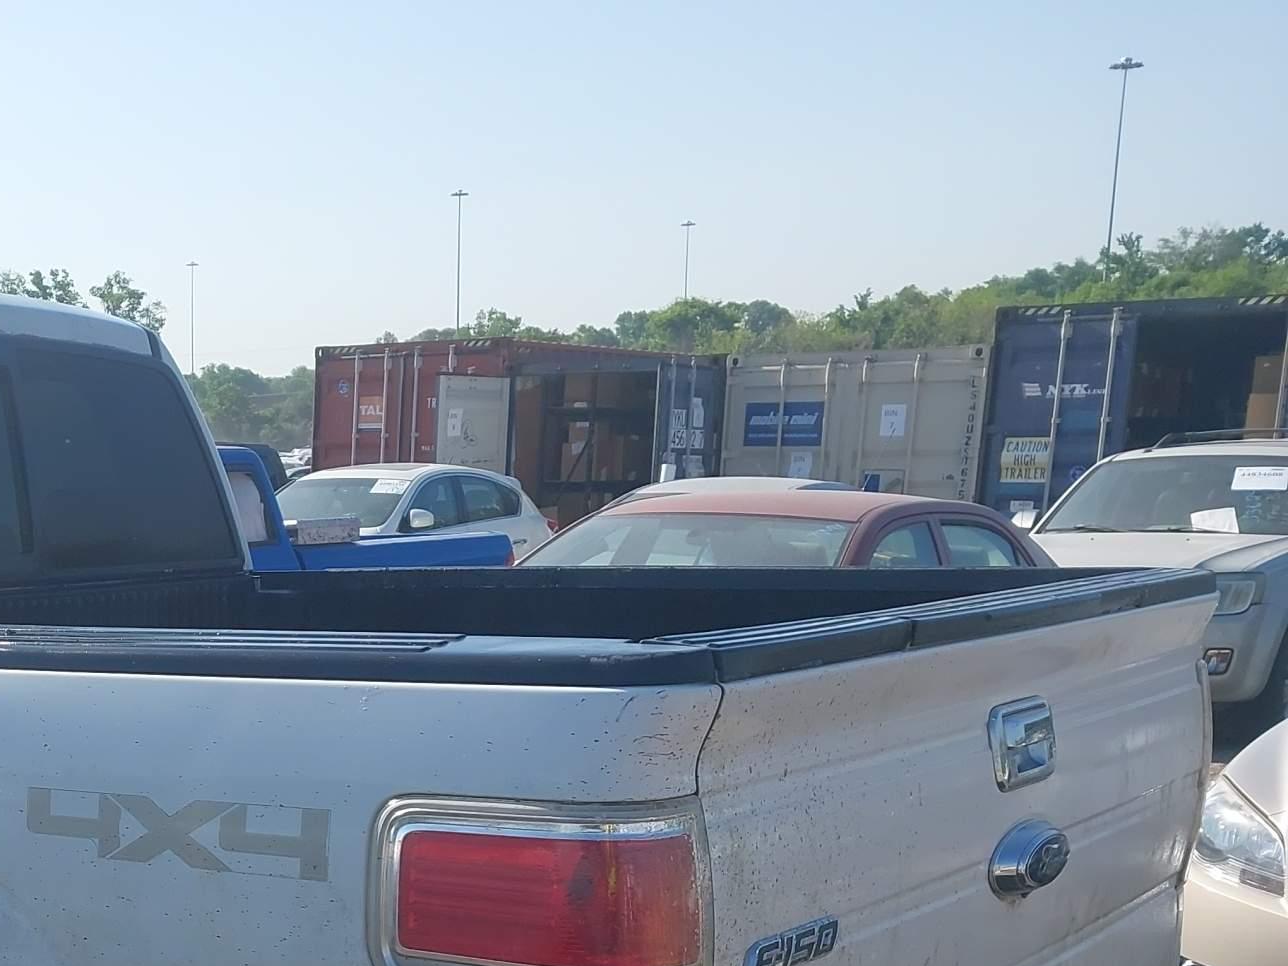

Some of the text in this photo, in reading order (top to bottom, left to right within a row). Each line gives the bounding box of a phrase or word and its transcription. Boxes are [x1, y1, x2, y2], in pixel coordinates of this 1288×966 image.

[359, 405, 383, 416] TAL
[1006, 440, 1049, 452] CAUTION
[1013, 454, 1036, 466] HIGH
[1005, 467, 1046, 480] TRAILER
